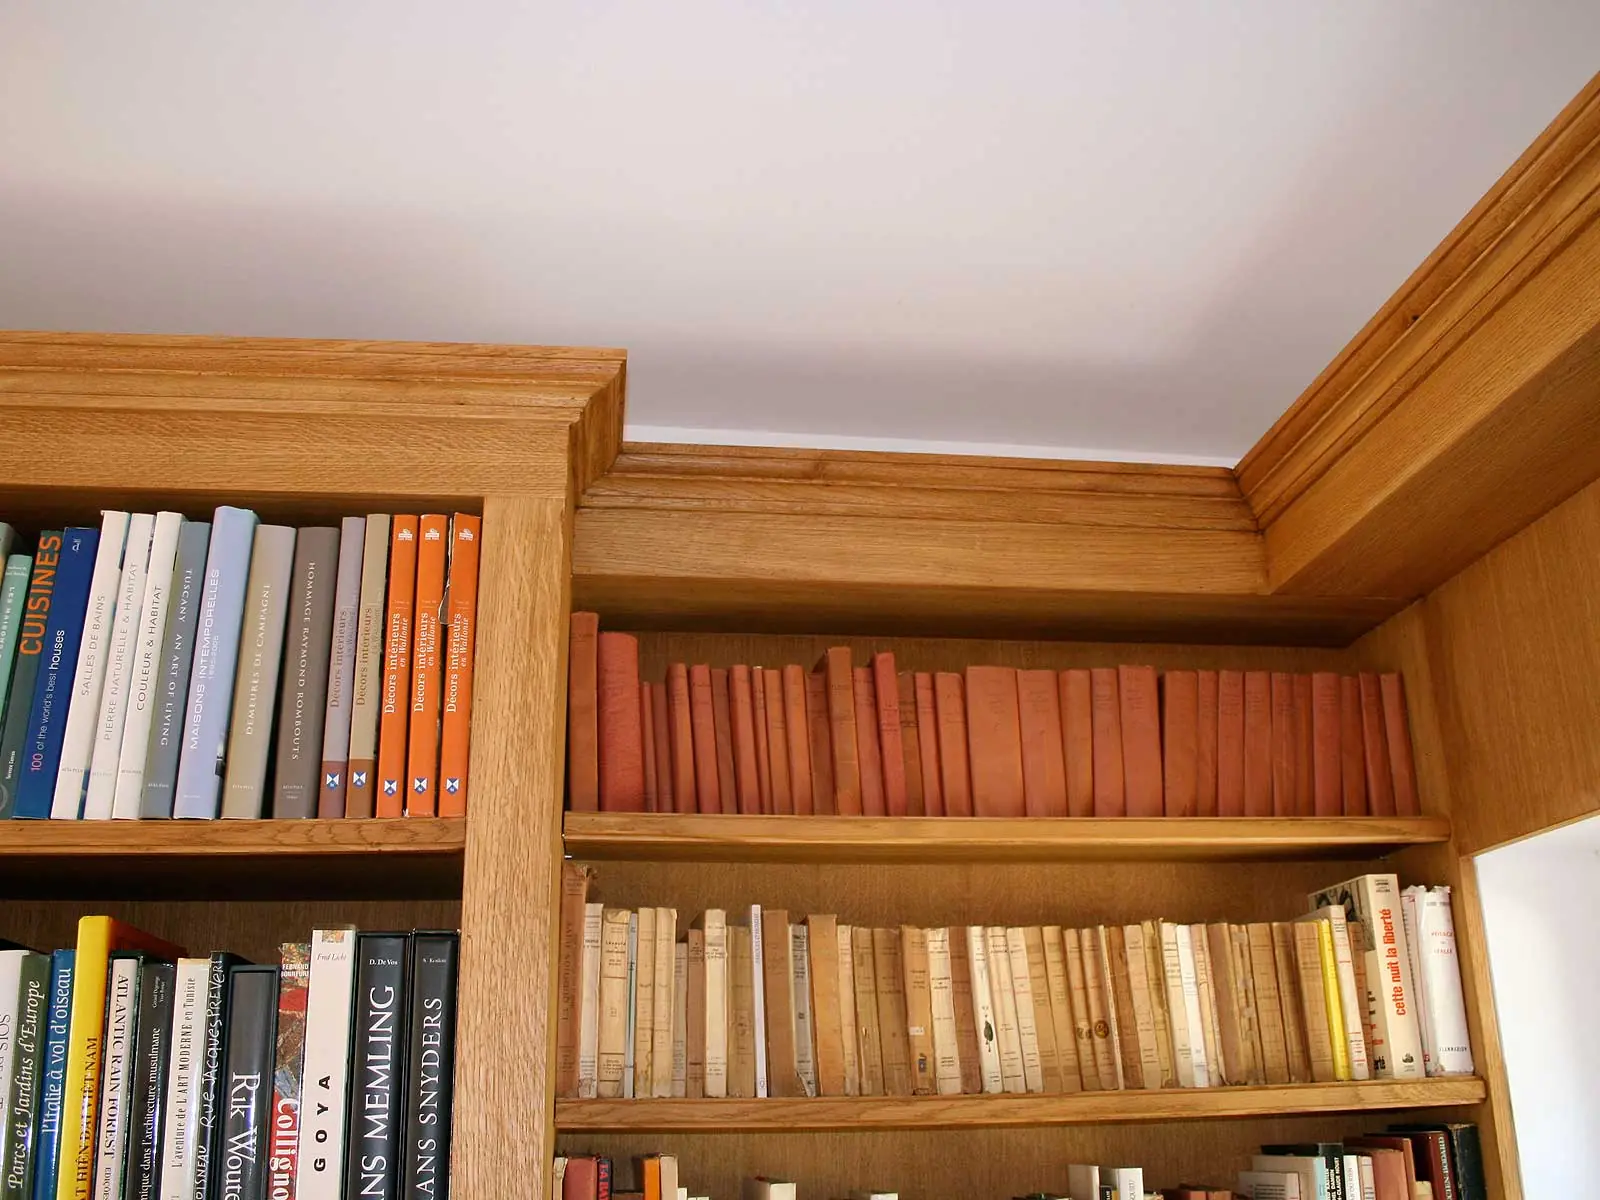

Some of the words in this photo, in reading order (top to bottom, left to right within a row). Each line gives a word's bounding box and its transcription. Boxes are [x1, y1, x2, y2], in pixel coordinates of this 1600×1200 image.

[20, 535, 61, 655] CUISINES
[124, 563, 138, 612] HABITAT
[178, 568, 193, 623] TUSCANY
[303, 561, 316, 624] HOMMAGE
[93, 595, 105, 630] BAINS
[123, 614, 130, 624] &
[148, 586, 162, 636] HABITAT
[256, 585, 270, 648] CAMPAGNE
[359, 607, 373, 658] intérieurs
[49, 630, 65, 670] houses
[90, 632, 99, 650] DE
[146, 640, 154, 650] &
[174, 633, 182, 651] AN
[333, 609, 348, 662] intérieurs
[387, 612, 402, 670] intérieurs
[400, 617, 409, 654] Wallonie
[417, 611, 430, 669] intérieurs
[428, 616, 437, 653] Wallonie
[449, 612, 462, 670] intérieurs
[461, 617, 469, 654] Wallonie
[81, 653, 96, 696] SALLES
[110, 629, 128, 696] NATURELLE
[170, 655, 180, 677] ART
[190, 684, 206, 750] MAISONS
[199, 568, 221, 678] INTEMPORELLES
[252, 650, 263, 667] DE
[298, 626, 311, 688] RAYMOND
[399, 655, 407, 668] en
[427, 654, 435, 667] en
[460, 654, 468, 668] en
[46, 672, 57, 691] best
[136, 652, 152, 711] COULEUR
[167, 681, 176, 699] OF
[245, 670, 260, 737] DEMEURES
[329, 664, 343, 708] Décors
[355, 660, 369, 707] Décors
[384, 671, 398, 713] Décors
[413, 671, 426, 713] Décors
[446, 671, 459, 713] Décors
[41, 692, 53, 720] world's
[104, 697, 117, 741] PIERRE
[160, 702, 173, 747] LIVING
[291, 692, 304, 761] ROMBOUTS
[36, 739, 44, 751] of
[38, 721, 48, 737] the
[31, 753, 43, 772] 100
[1379, 908, 1396, 945] liberté
[1386, 947, 1398, 958] la
[1387, 961, 1401, 983] nuit
[51, 967, 72, 1034] d'oiseau
[112, 974, 129, 1050] ATLANTIC
[183, 977, 196, 1008] Tunisie
[1392, 986, 1406, 1016] cette
[19, 980, 45, 1053] d'Europe
[183, 1011, 193, 1021] en
[49, 1039, 66, 1065] vol
[149, 1028, 161, 1083] musulmane
[178, 1023, 193, 1071] MODERNE
[364, 985, 395, 1141] MEMLING
[418, 998, 442, 1127] SNYDERS
[14, 1058, 33, 1117] Jardins
[46, 1068, 63, 1080] à
[108, 1055, 123, 1093] RAIN
[175, 1075, 188, 1104] L'ART
[230, 1071, 261, 1119] Rik
[15, 1119, 28, 1137] et
[41, 1083, 62, 1135] l'Italie
[103, 1097, 119, 1159] FOREST
[141, 1086, 158, 1145] l'architecture
[174, 1108, 186, 1119] de
[199, 1092, 215, 1128] Rue
[313, 1075, 330, 1172] GOYA
[8, 1143, 26, 1190] Parcs
[139, 1147, 153, 1171] dans
[171, 1122, 185, 1168] L'aventure
[270, 1098, 299, 1200] Colligno
[360, 1155, 387, 1200] NS
[415, 1138, 437, 1200] ANS
